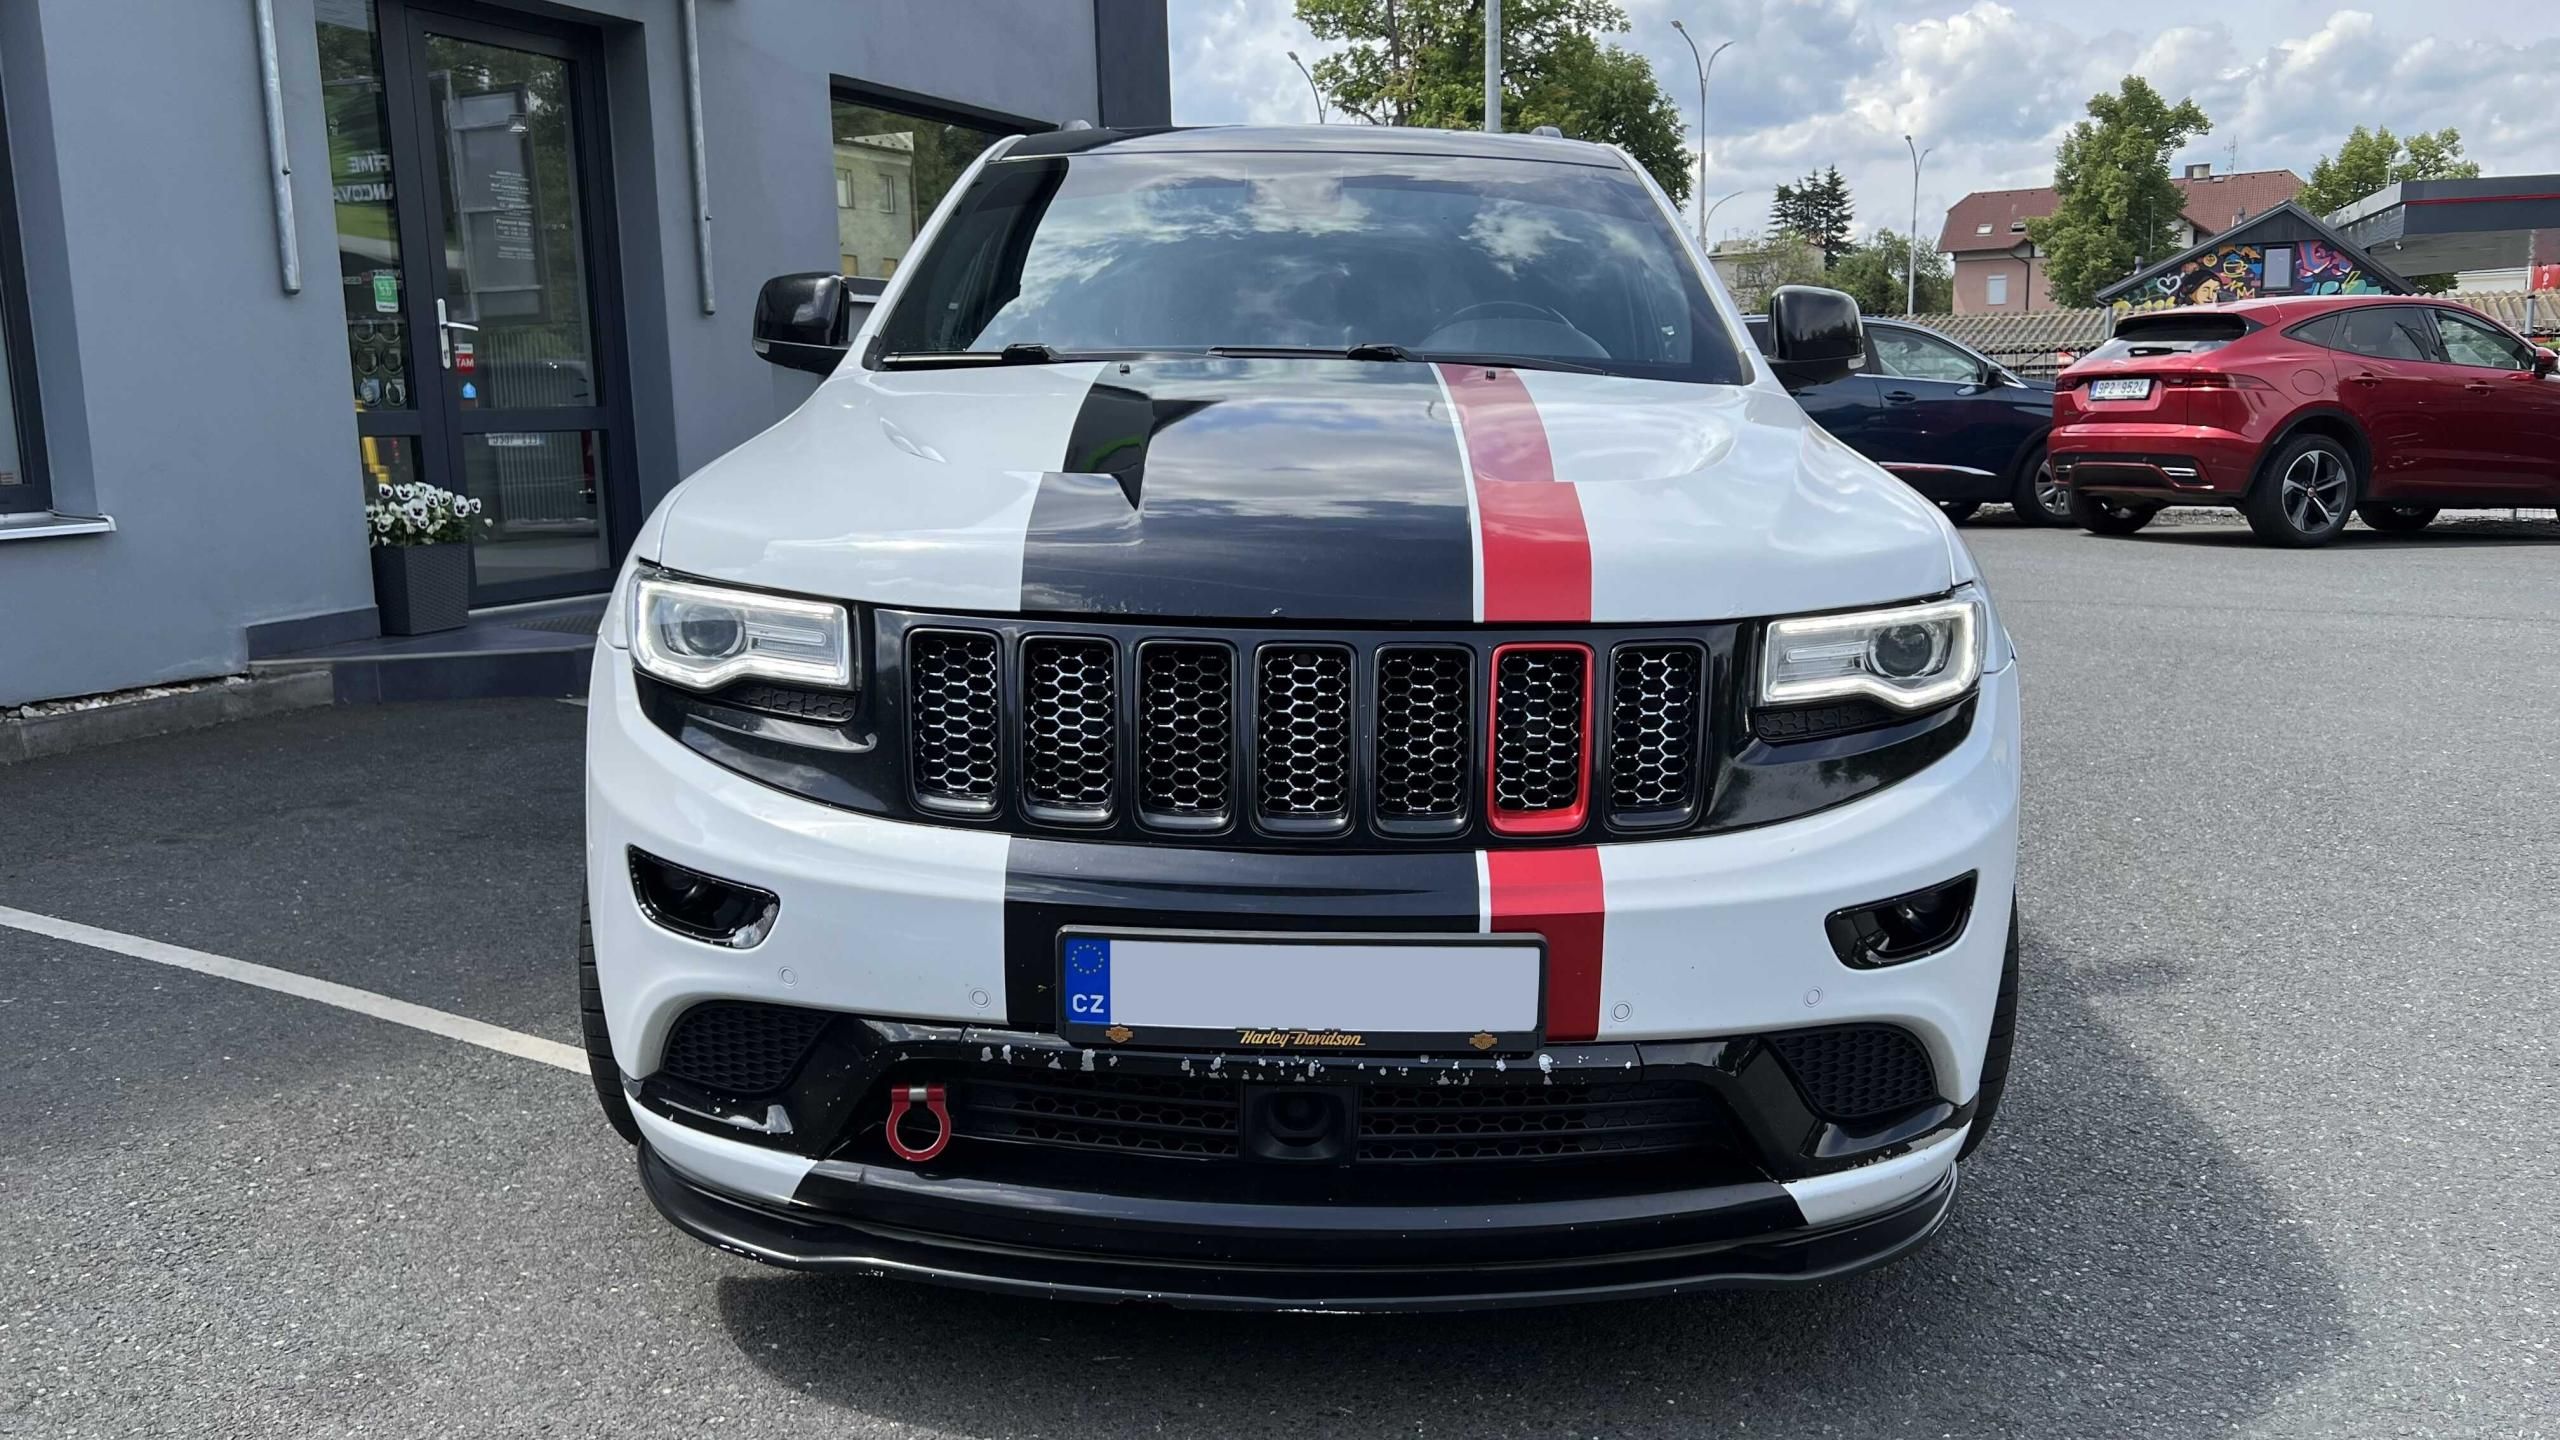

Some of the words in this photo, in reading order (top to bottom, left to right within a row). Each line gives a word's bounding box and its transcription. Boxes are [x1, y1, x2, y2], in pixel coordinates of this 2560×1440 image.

[456, 358, 475, 368] TAM
[2097, 381, 2115, 395] 9P2
[2120, 381, 2144, 394] 9524
[1072, 993, 1105, 1014] CZ
[1236, 1030, 1366, 1047] Harley-Davidson
